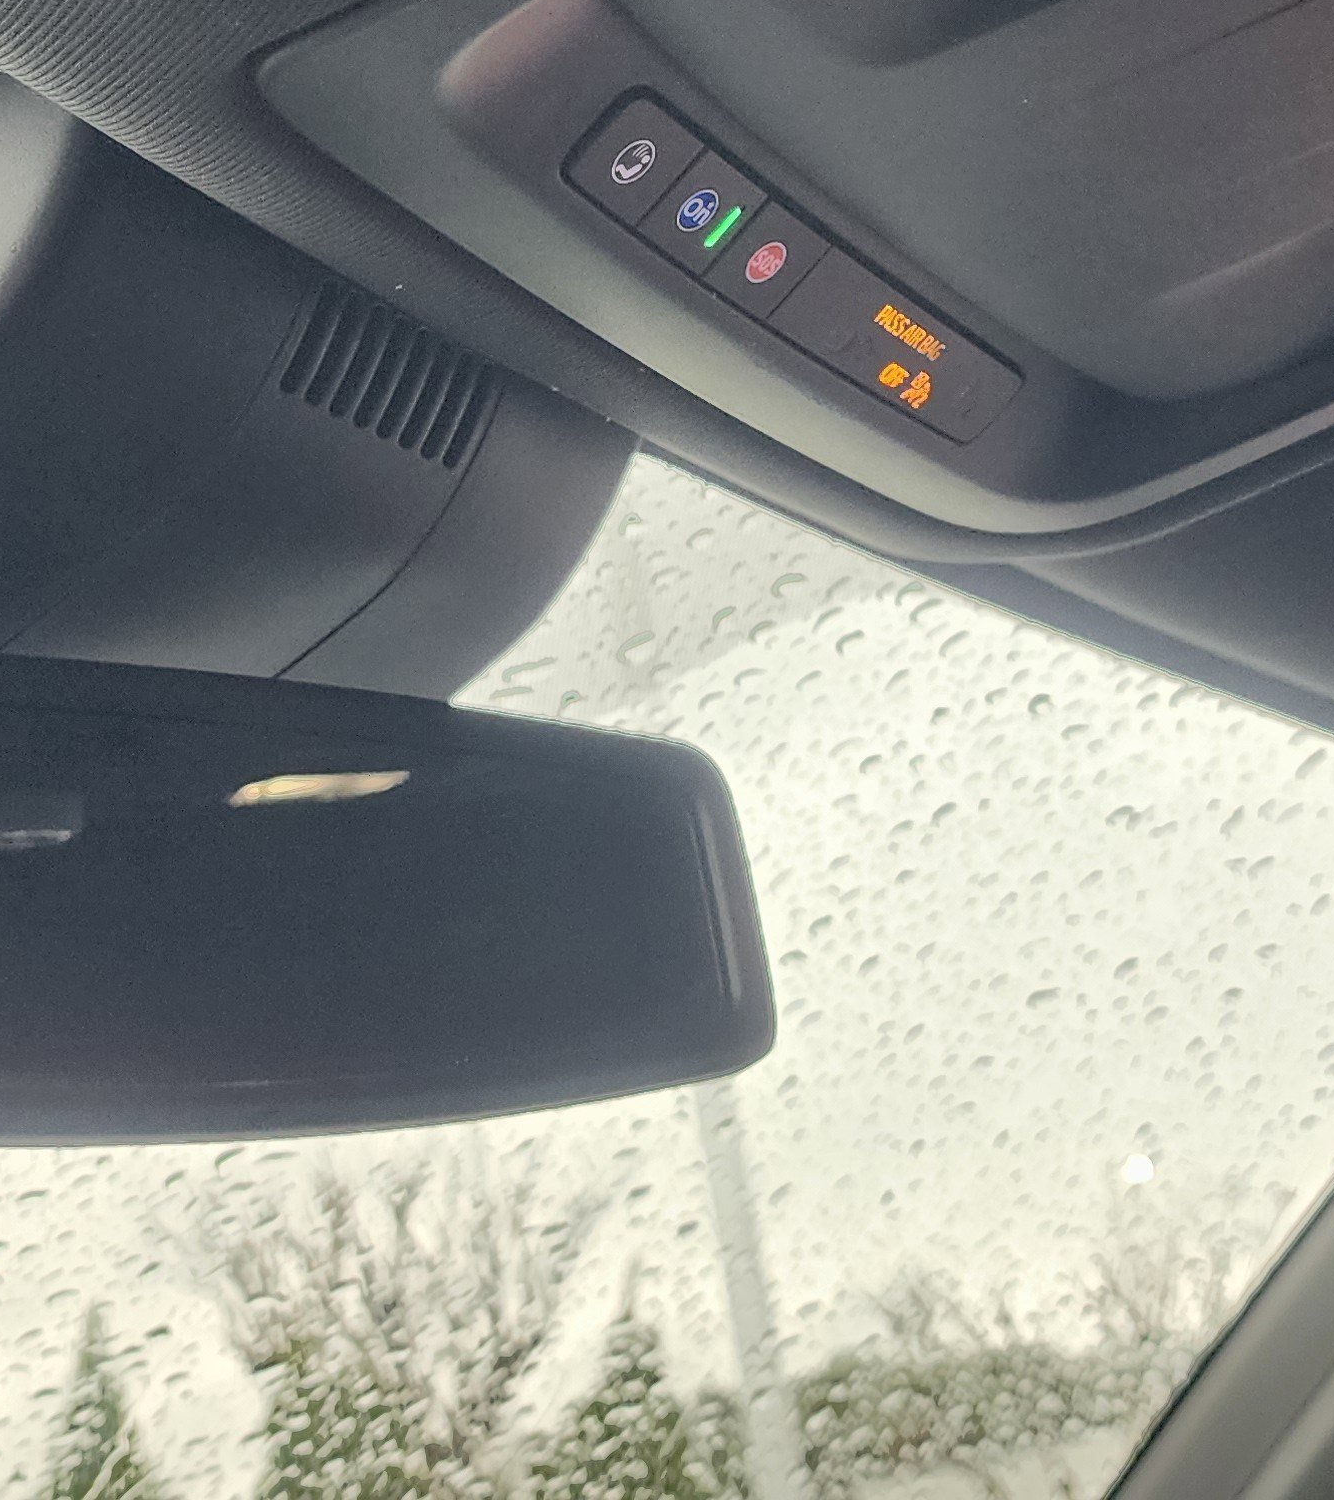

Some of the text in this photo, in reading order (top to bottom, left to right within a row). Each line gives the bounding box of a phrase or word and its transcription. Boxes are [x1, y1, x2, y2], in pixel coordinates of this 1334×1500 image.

[683, 198, 711, 225] On
[750, 250, 782, 275] SOS
[873, 305, 910, 337] PASS
[878, 362, 910, 388] OFF
